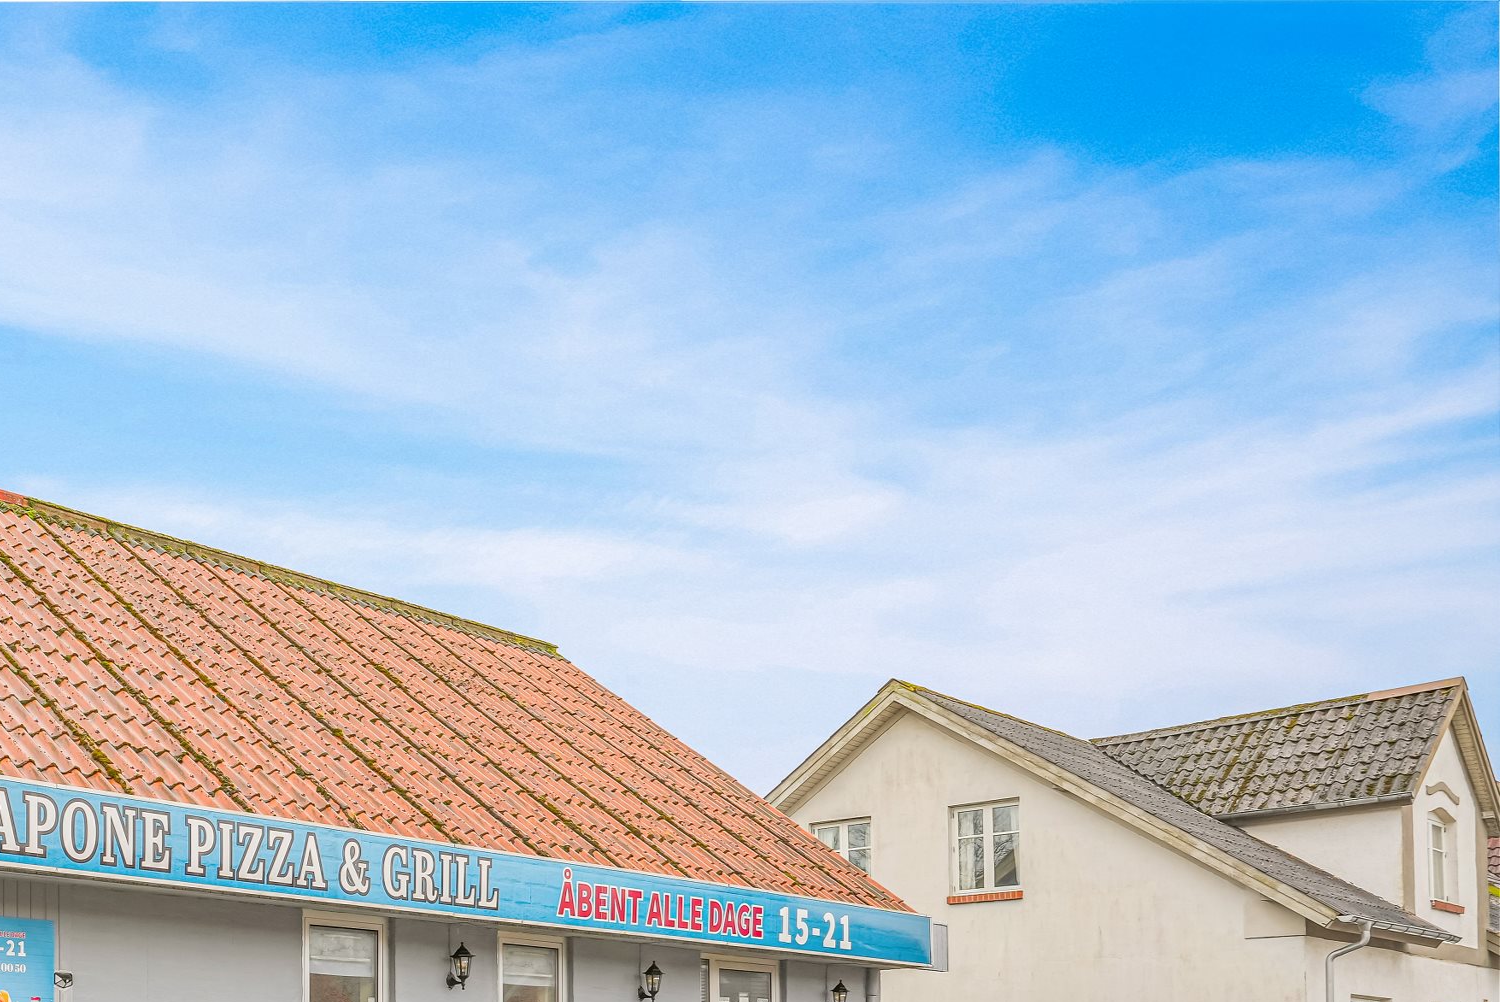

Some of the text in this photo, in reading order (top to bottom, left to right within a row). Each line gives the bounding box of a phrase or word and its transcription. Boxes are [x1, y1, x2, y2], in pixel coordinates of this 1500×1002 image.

[185, 814, 329, 891] PIZZA
[339, 838, 371, 896] &
[382, 844, 499, 911] GRILL
[556, 867, 852, 950] ÅBENT ALLE DAGE 15-21
[14, 963, 27, 973] 50
